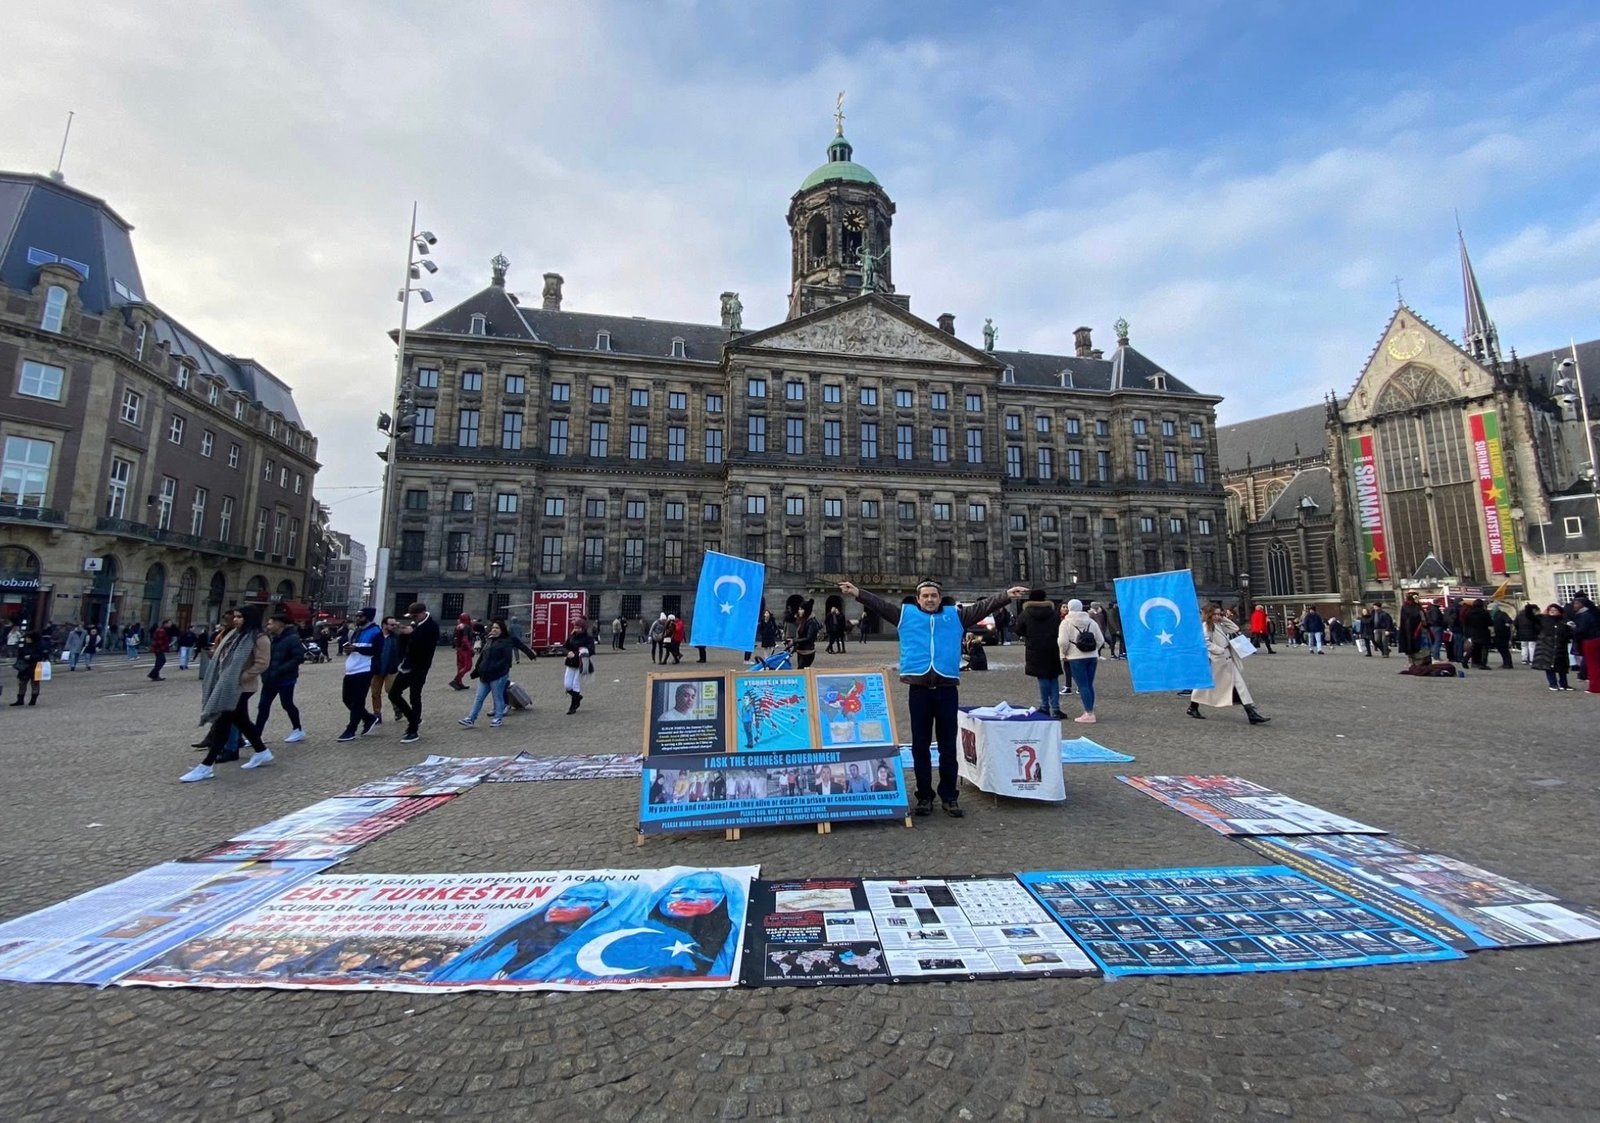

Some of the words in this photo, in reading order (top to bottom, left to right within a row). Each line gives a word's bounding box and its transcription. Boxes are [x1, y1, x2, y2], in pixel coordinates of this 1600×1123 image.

[1474, 440, 1492, 480] SURINAME
[1354, 464, 1381, 528] SRANAN
[1484, 505, 1500, 538] LAATSTE
[1499, 508, 1512, 532] MAART
[1490, 538, 1502, 555] DAG
[1502, 534, 1515, 554] 2020
[0, 578, 40, 588] obank
[704, 758, 708, 768] I
[710, 757, 728, 768] ASK
[730, 756, 745, 767] THE
[748, 754, 783, 766] CHINESE
[785, 752, 840, 764] GOVERNMENT
[659, 804, 683, 813] parents
[698, 801, 727, 810] relatives!
[741, 800, 754, 808] they
[780, 797, 798, 805] dead?
[835, 794, 876, 802] concentration
[459, 876, 557, 884] HAPPENING
[281, 887, 370, 900] EAST
[370, 885, 552, 900] TURKESTAN
[258, 904, 334, 912] OCCUPIED
[335, 904, 356, 912] BY
[358, 903, 408, 911] CHINA
[410, 903, 448, 912] (AKA
